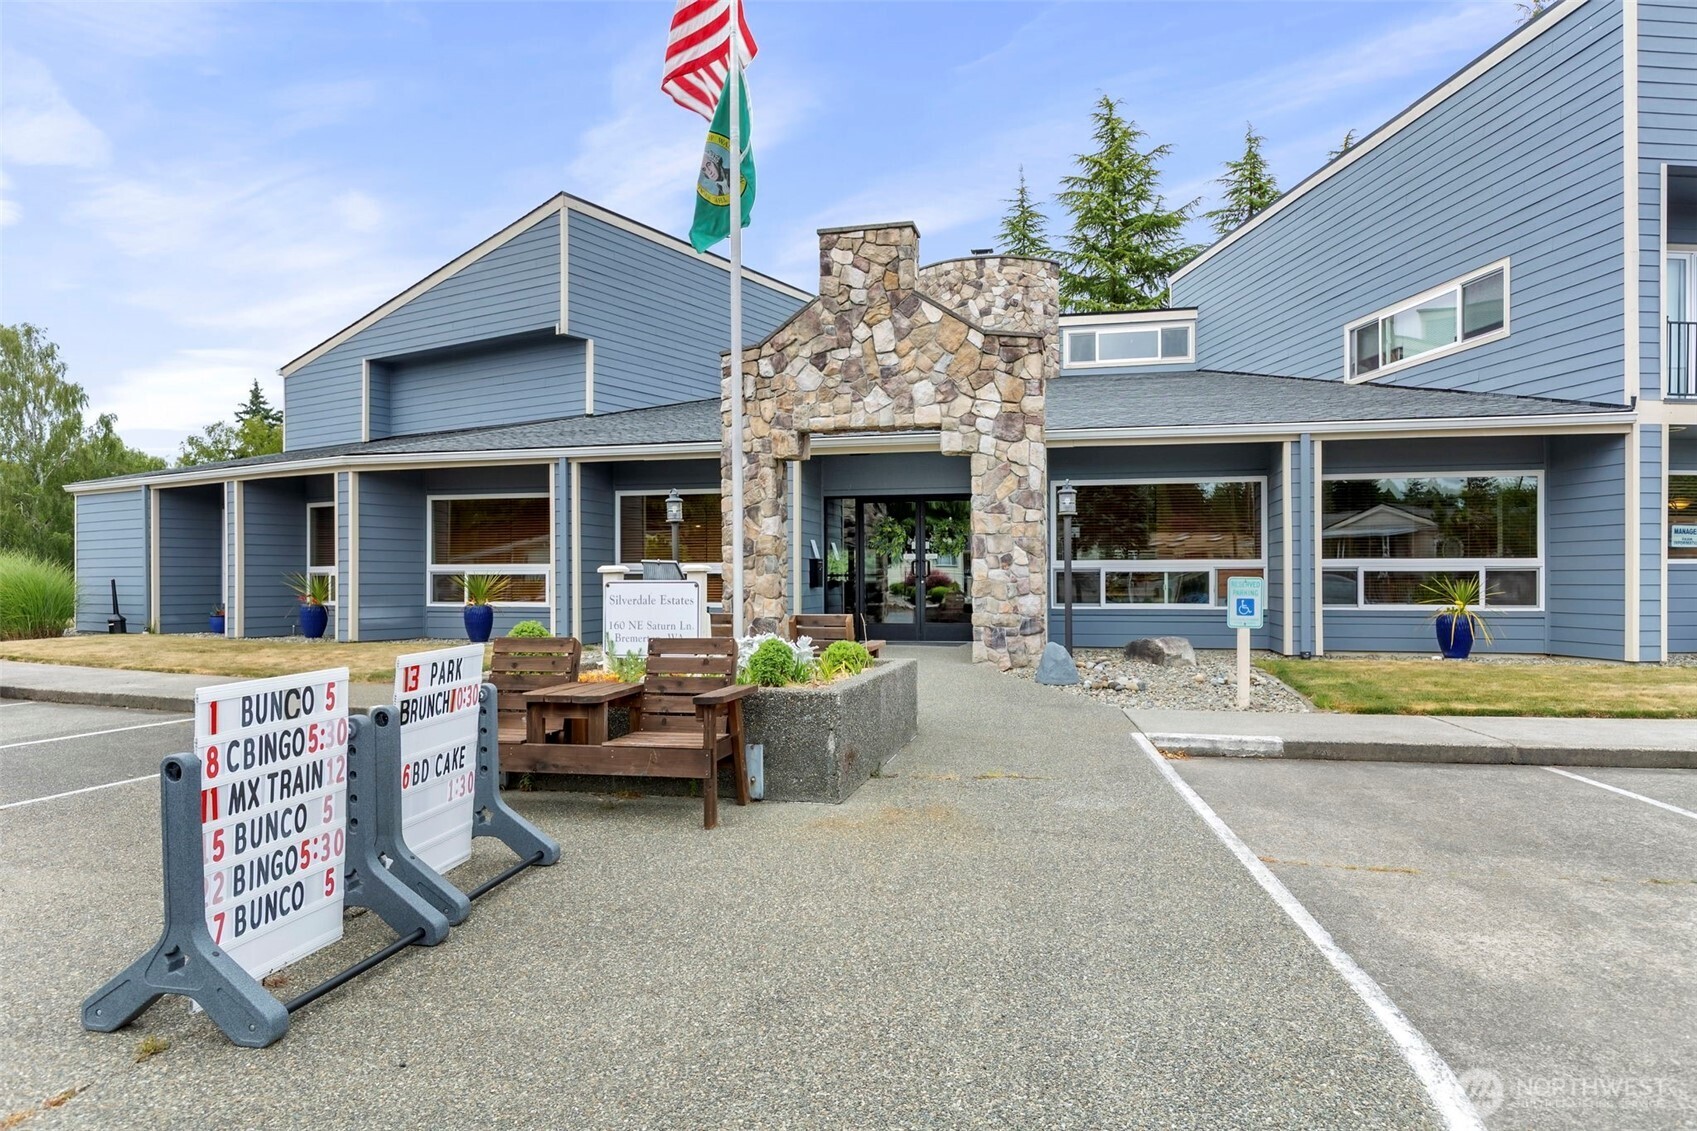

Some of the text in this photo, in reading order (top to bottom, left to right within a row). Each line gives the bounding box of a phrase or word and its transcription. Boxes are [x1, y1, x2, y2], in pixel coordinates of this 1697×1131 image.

[609, 594, 694, 606] Silverdale Estates
[609, 621, 694, 630] 160 NE Saturn Ln.
[403, 658, 463, 693] 13 PARK
[210, 681, 336, 735] 1 BUNCO 5
[400, 684, 479, 726] BRUNCH 10:30
[206, 745, 219, 779] 8
[307, 717, 347, 754] 5:30
[402, 745, 466, 789] 6 BD CAKE
[201, 758, 345, 824] 11 MX TRAIN 12
[447, 770, 474, 802] 1:30
[235, 803, 307, 856] BUNCO
[322, 794, 333, 824] 5
[233, 845, 299, 898] BINGO
[299, 828, 345, 870] 5:30
[235, 880, 305, 938] BUNCO
[325, 867, 336, 897] 5
